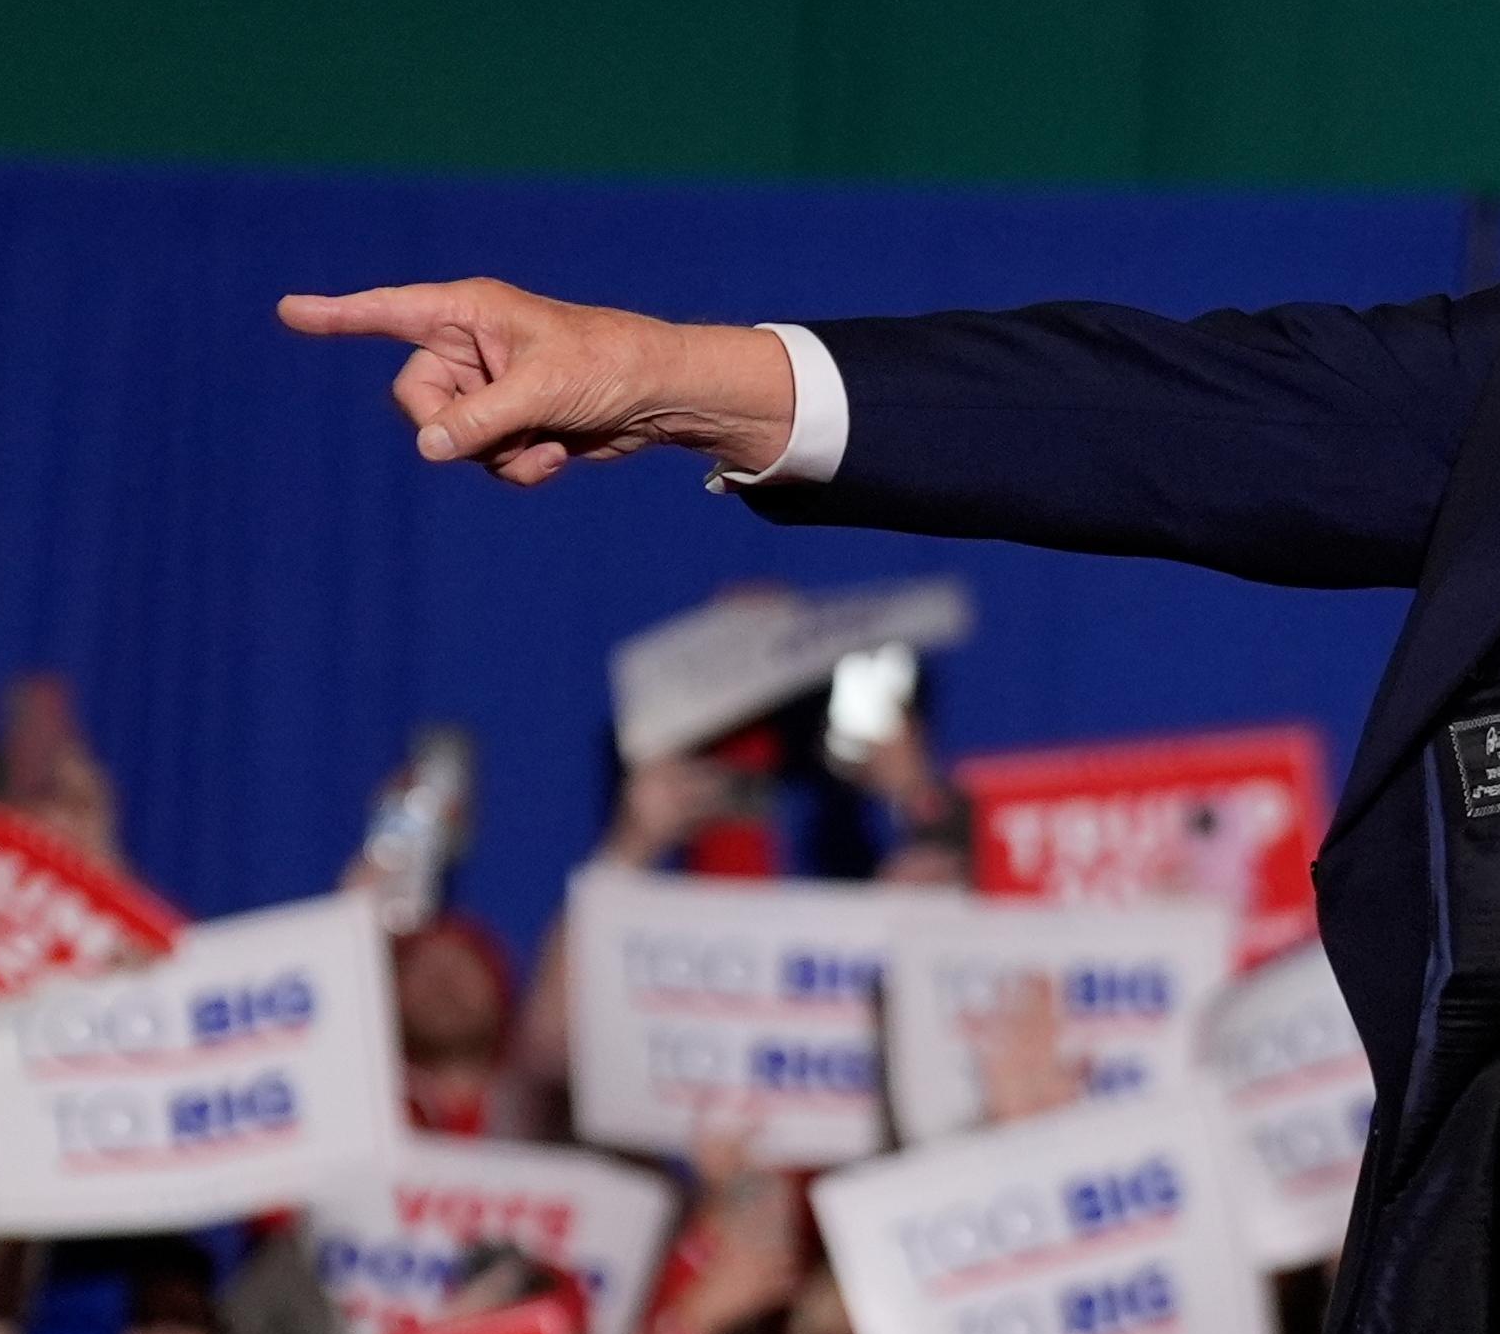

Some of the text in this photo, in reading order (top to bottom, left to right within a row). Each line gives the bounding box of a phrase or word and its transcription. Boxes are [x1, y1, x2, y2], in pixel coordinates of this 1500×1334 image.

[994, 783, 1292, 877] TRUP
[190, 973, 316, 1049] BIG
[1064, 961, 1177, 1019] BIG
[168, 1069, 300, 1147] RIG
[1062, 1157, 1190, 1233] BIG
